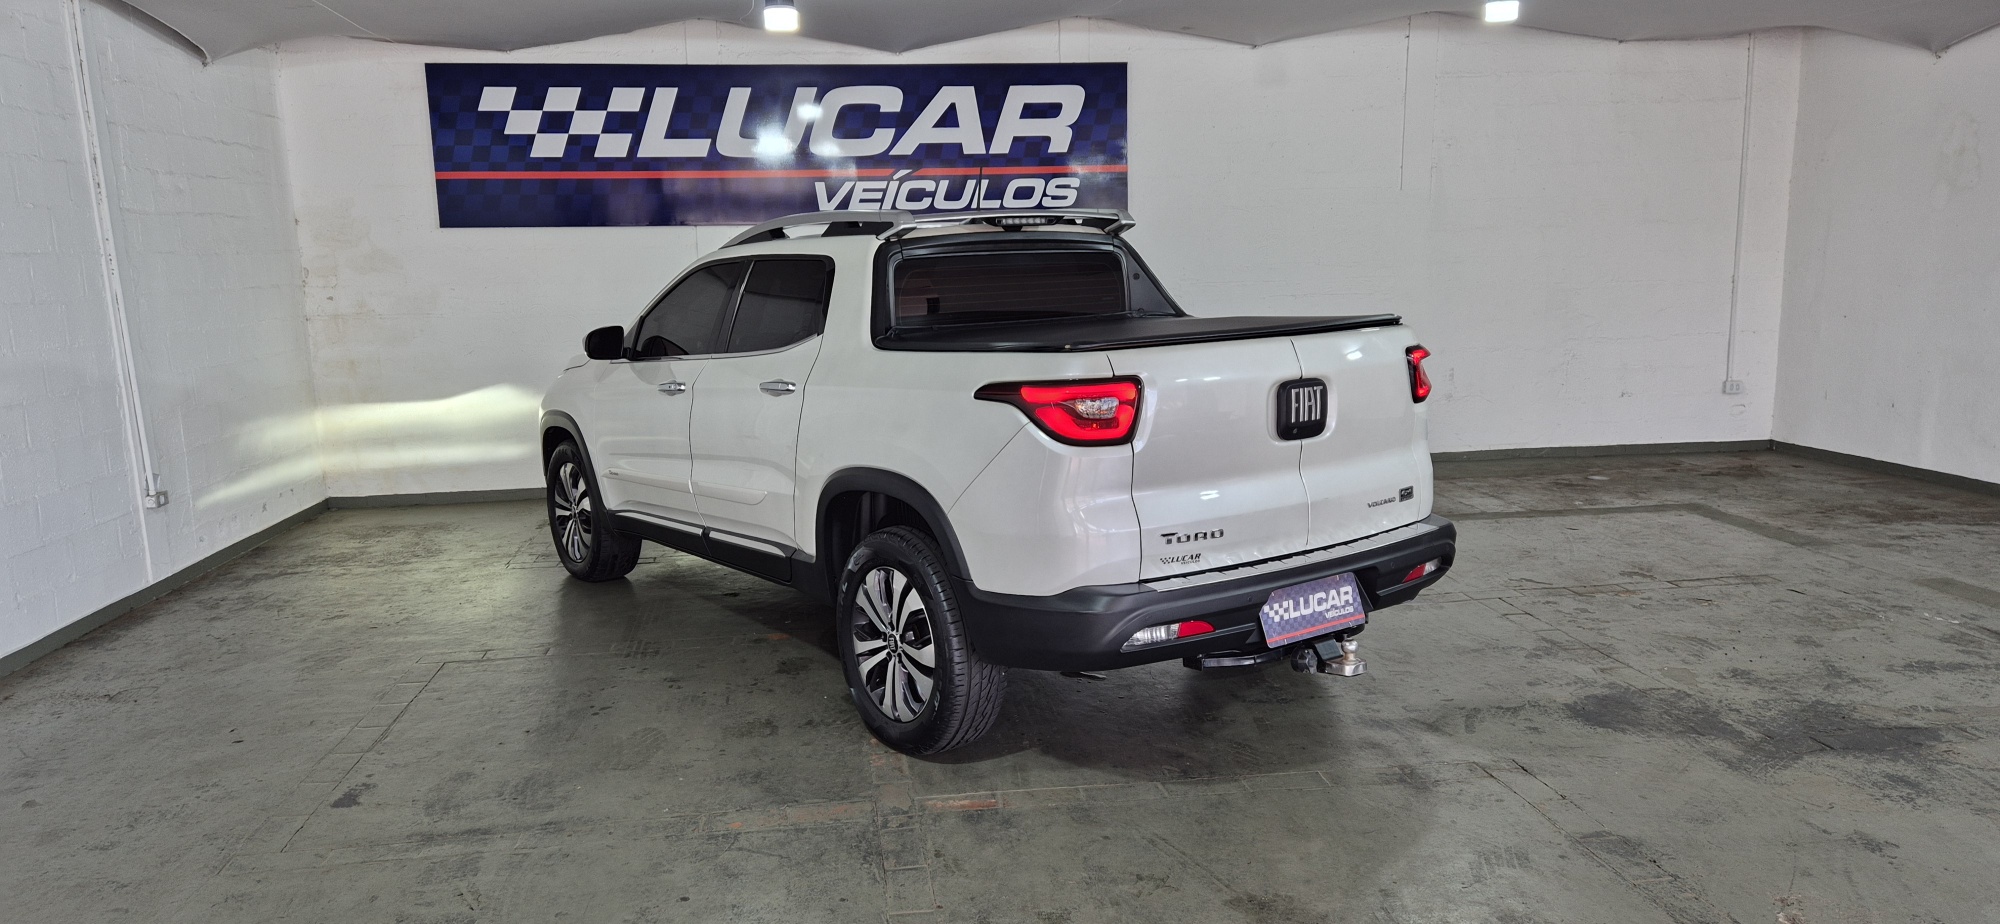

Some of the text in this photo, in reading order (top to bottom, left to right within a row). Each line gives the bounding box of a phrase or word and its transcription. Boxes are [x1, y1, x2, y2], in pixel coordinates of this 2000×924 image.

[637, 85, 1086, 158] LUCAR
[814, 169, 1081, 210] VEÍCULOS
[1291, 386, 1323, 423] FIAT
[1160, 529, 1224, 544] TORO
[1170, 553, 1201, 563] LUCAR
[1289, 586, 1354, 618] LUCAR
